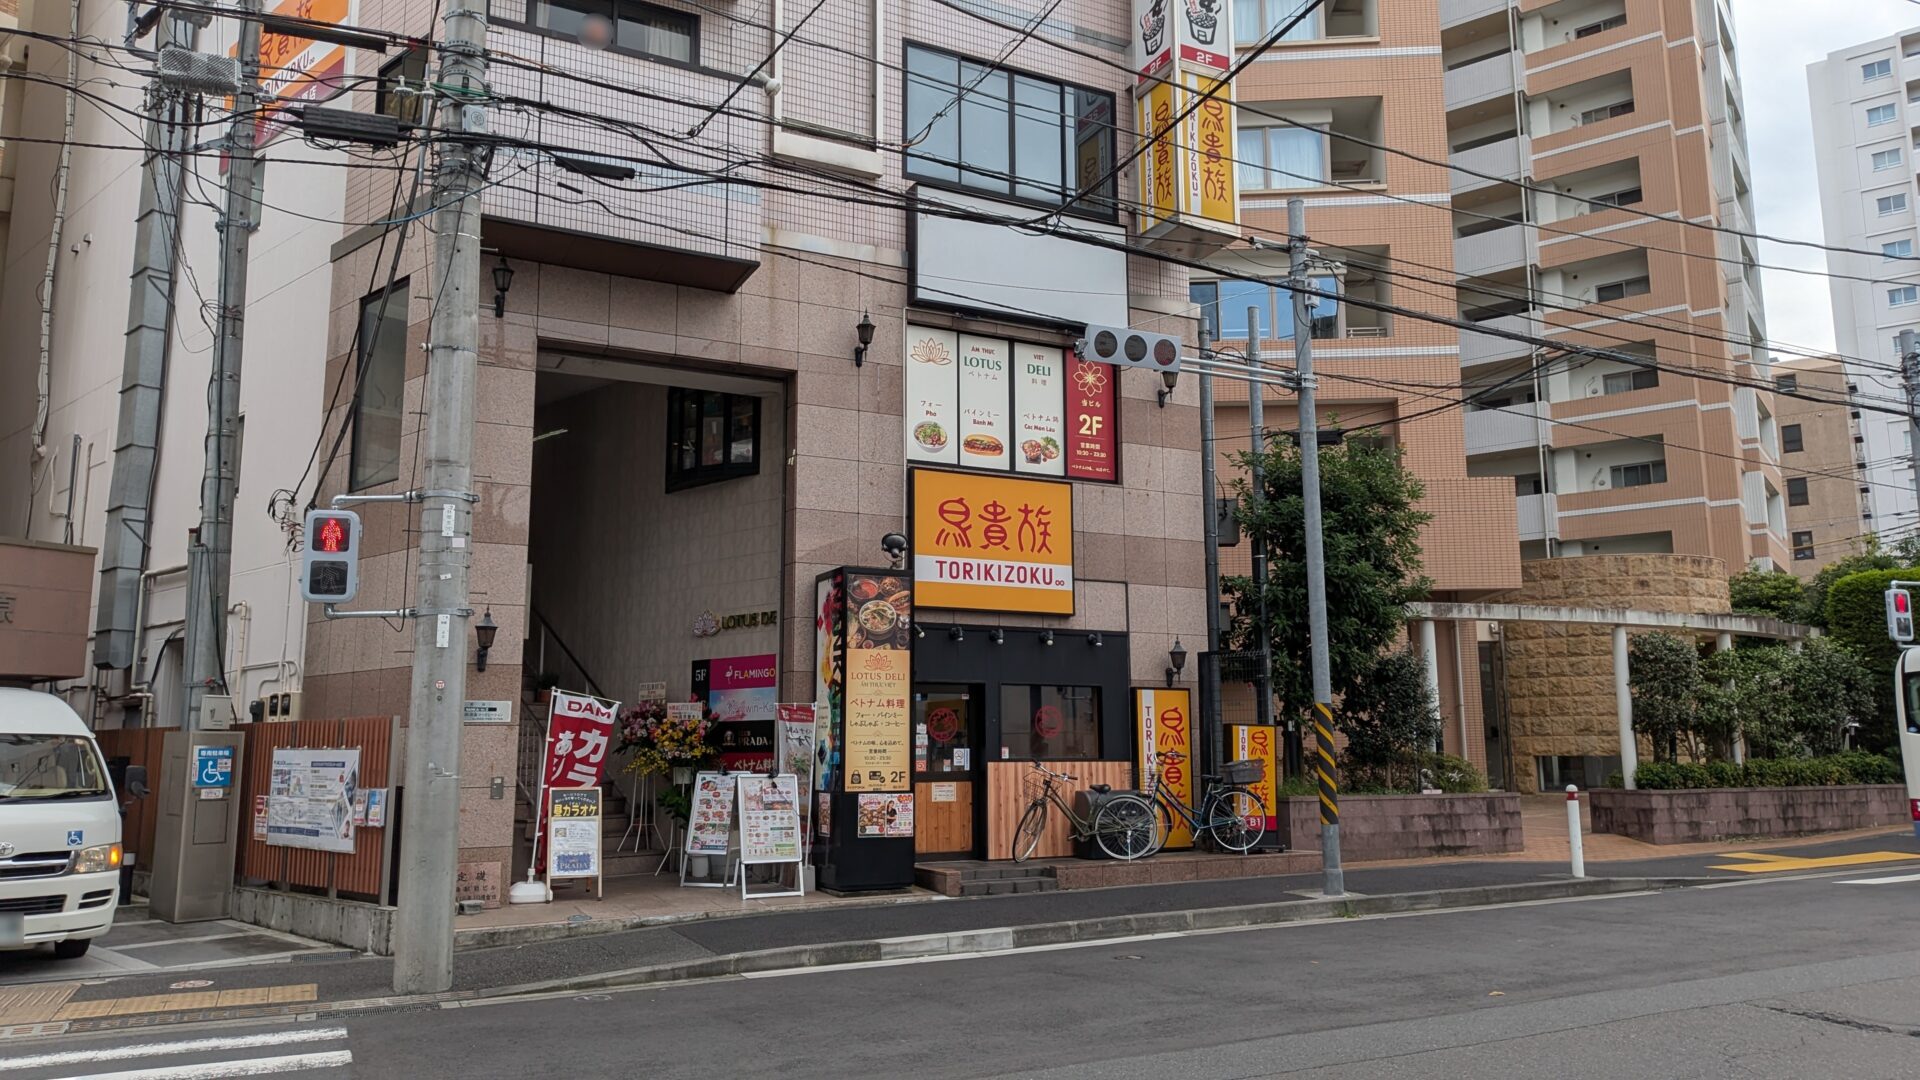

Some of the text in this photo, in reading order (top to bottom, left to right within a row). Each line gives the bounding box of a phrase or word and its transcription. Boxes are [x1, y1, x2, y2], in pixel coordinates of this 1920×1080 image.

[1196, 52, 1212, 64] 2F
[1150, 57, 1162, 74] 2F
[1202, 98, 1227, 203] 鳥貴族
[1145, 111, 1153, 206] TORKIZOKU
[964, 356, 1002, 371] LOTUS
[1027, 363, 1051, 376] DELI
[968, 370, 998, 380] ベトナム
[964, 408, 1000, 417] バインミー
[1079, 414, 1103, 435] 2F
[935, 496, 1052, 554] 鳥貴族
[935, 560, 1053, 586] TORIKIZOKU
[722, 612, 760, 629] LOTUS
[696, 669, 707, 682] 5F
[734, 668, 776, 680] FLAMINGO
[851, 672, 905, 680] LOTUS DELI
[567, 701, 611, 719] DAM
[850, 698, 905, 708] ベトナム料理
[566, 728, 608, 788] カラ
[734, 758, 774, 772] ベトナム料
[891, 771, 906, 783] 2F
[1251, 730, 1270, 810] 鳥族
[554, 804, 597, 816] 昼カラオケ
[1250, 818, 1260, 827] B1
